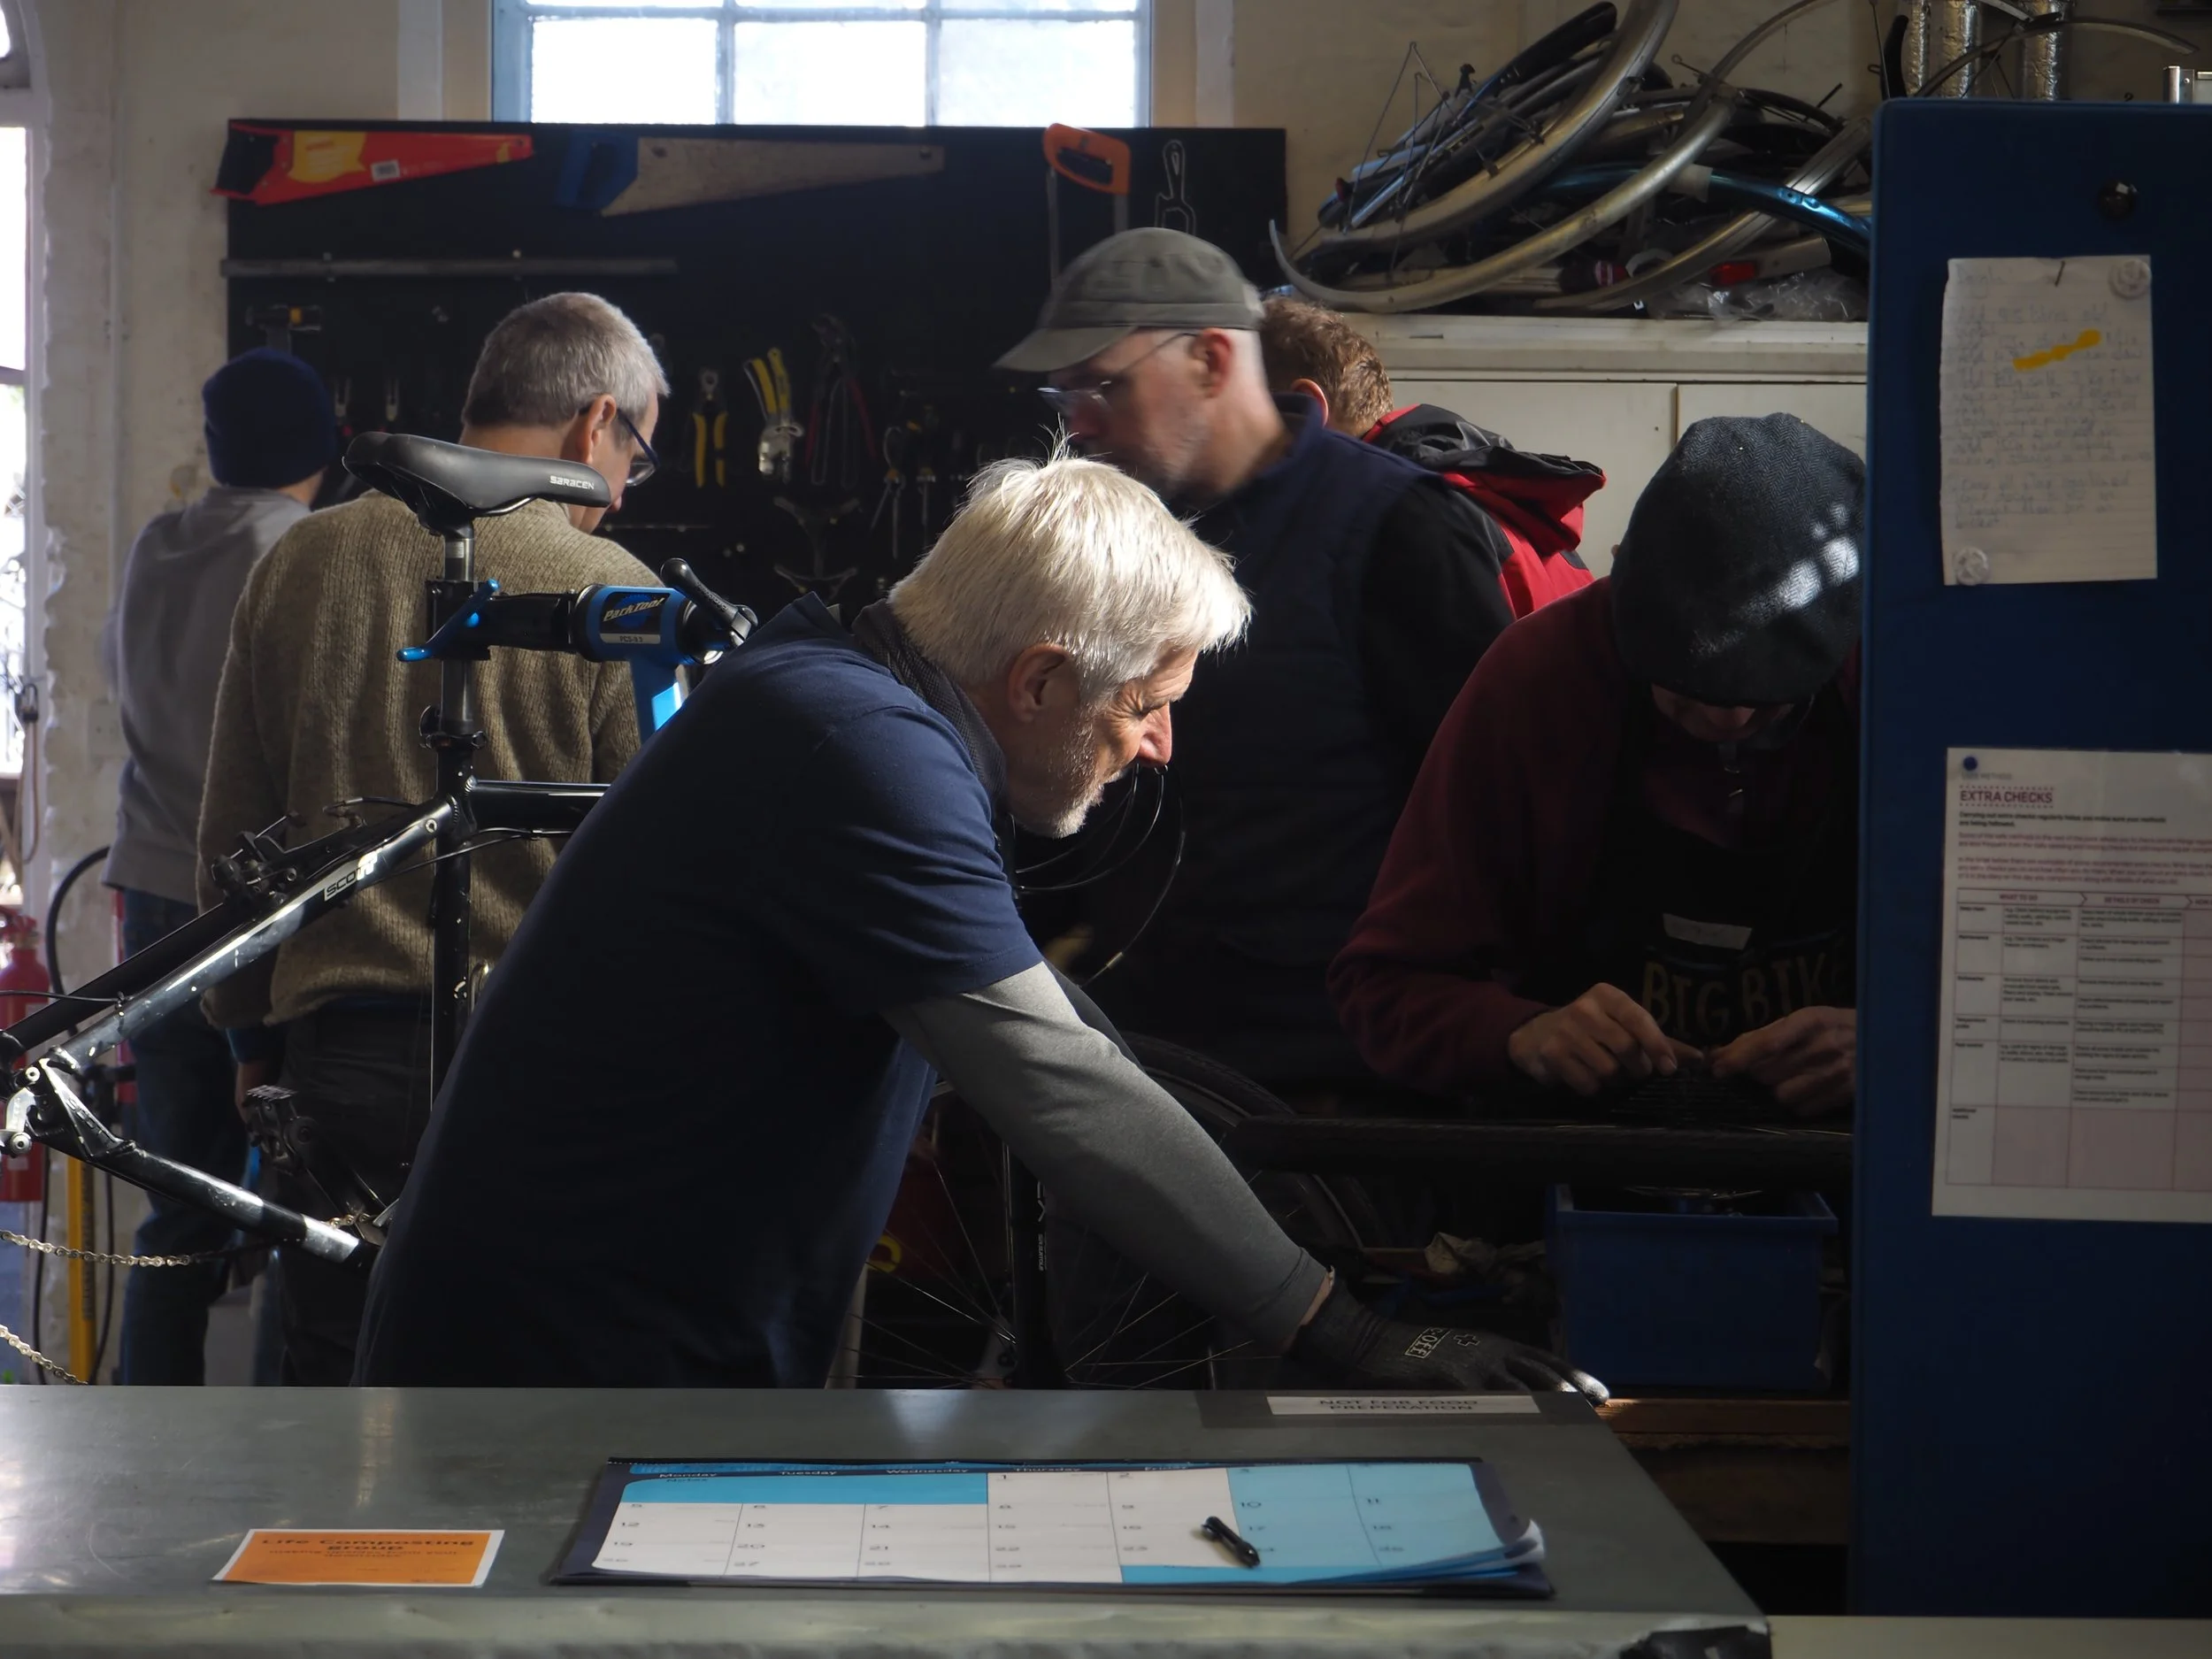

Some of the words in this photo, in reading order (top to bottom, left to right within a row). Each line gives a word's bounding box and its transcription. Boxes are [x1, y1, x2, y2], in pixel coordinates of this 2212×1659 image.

[1960, 790, 2001, 803] EXTRA
[2004, 792, 2053, 804] CHECKS
[1641, 961, 1731, 1039] BIG
